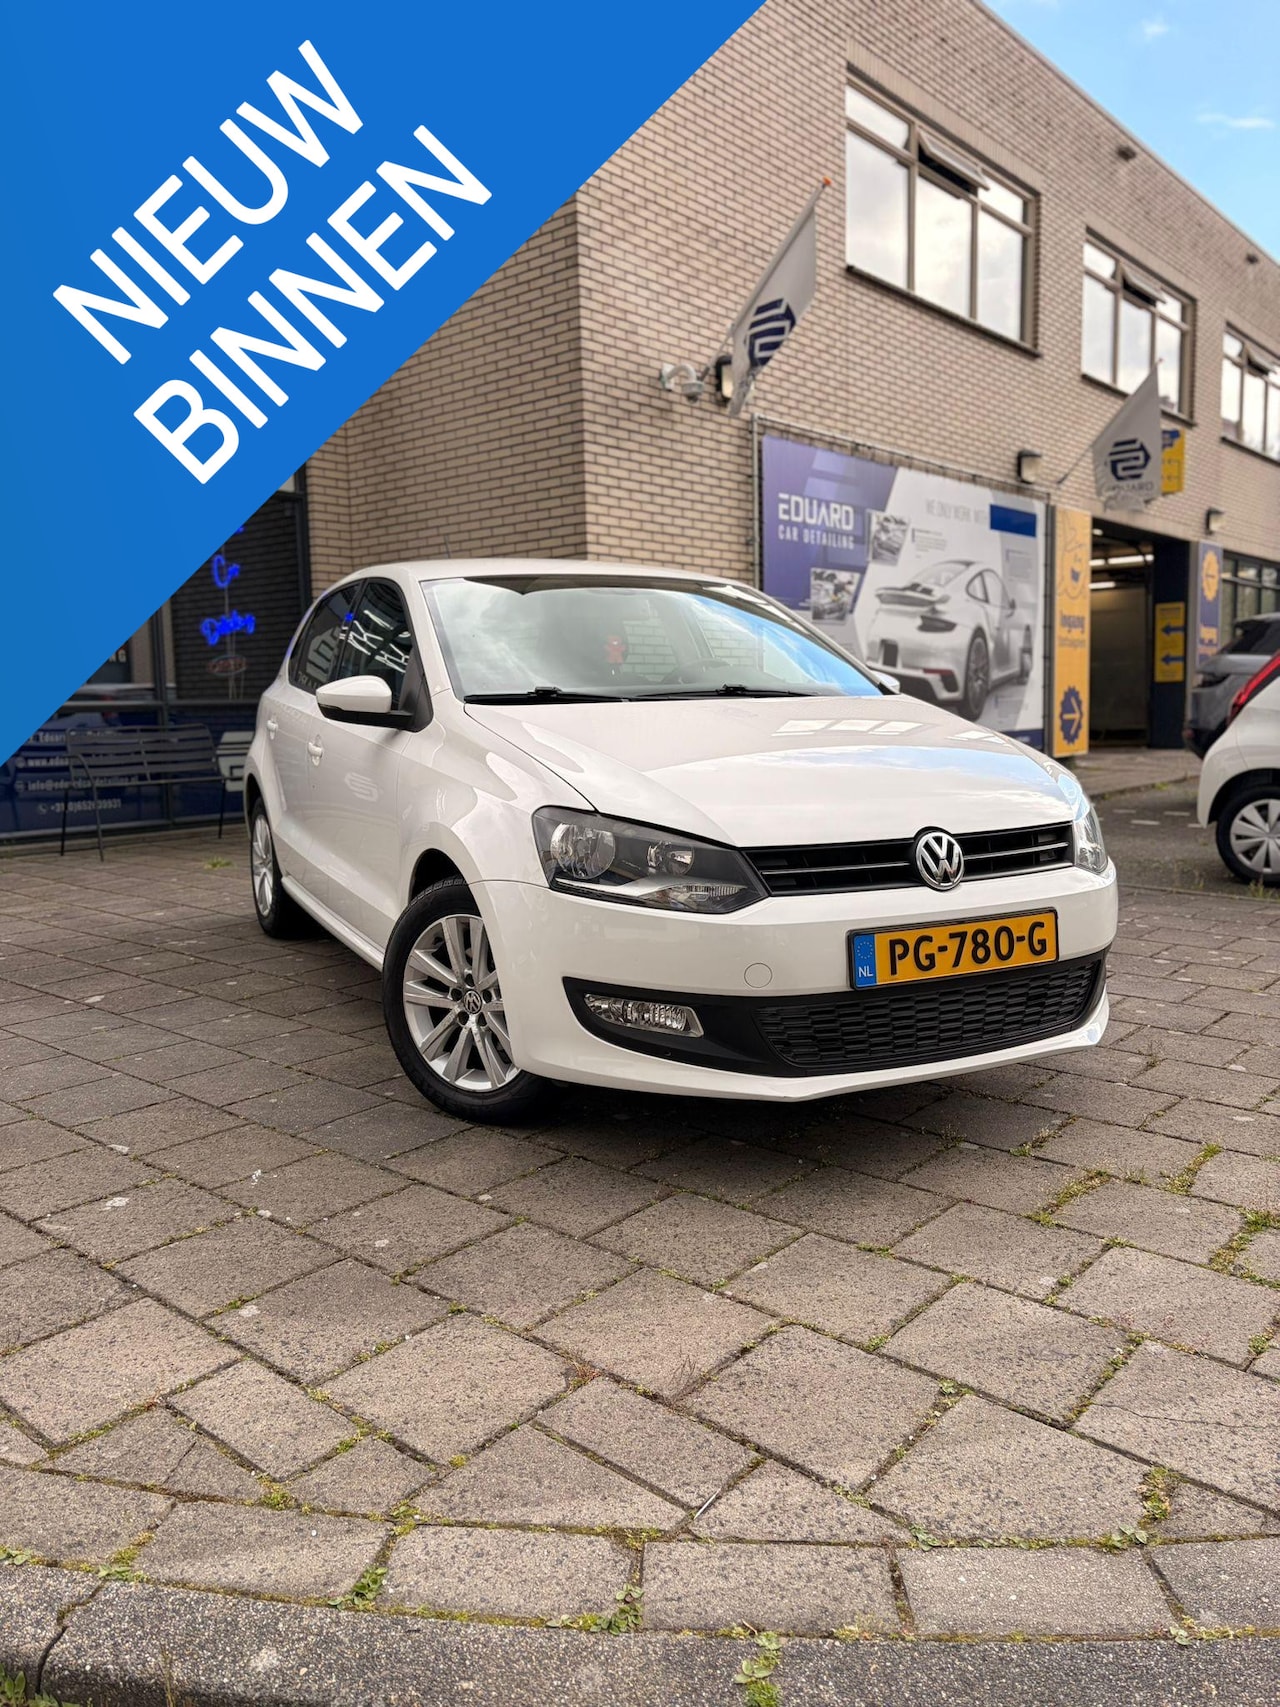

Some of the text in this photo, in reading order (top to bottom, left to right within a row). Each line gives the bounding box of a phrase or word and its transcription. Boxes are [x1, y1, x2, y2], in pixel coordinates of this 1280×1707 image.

[778, 493, 854, 531] EDUARD
[778, 524, 854, 549] CAR DETAILING
[916, 831, 965, 891] VW
[889, 921, 1047, 976] PG-780-G
[858, 966, 873, 977] NL
